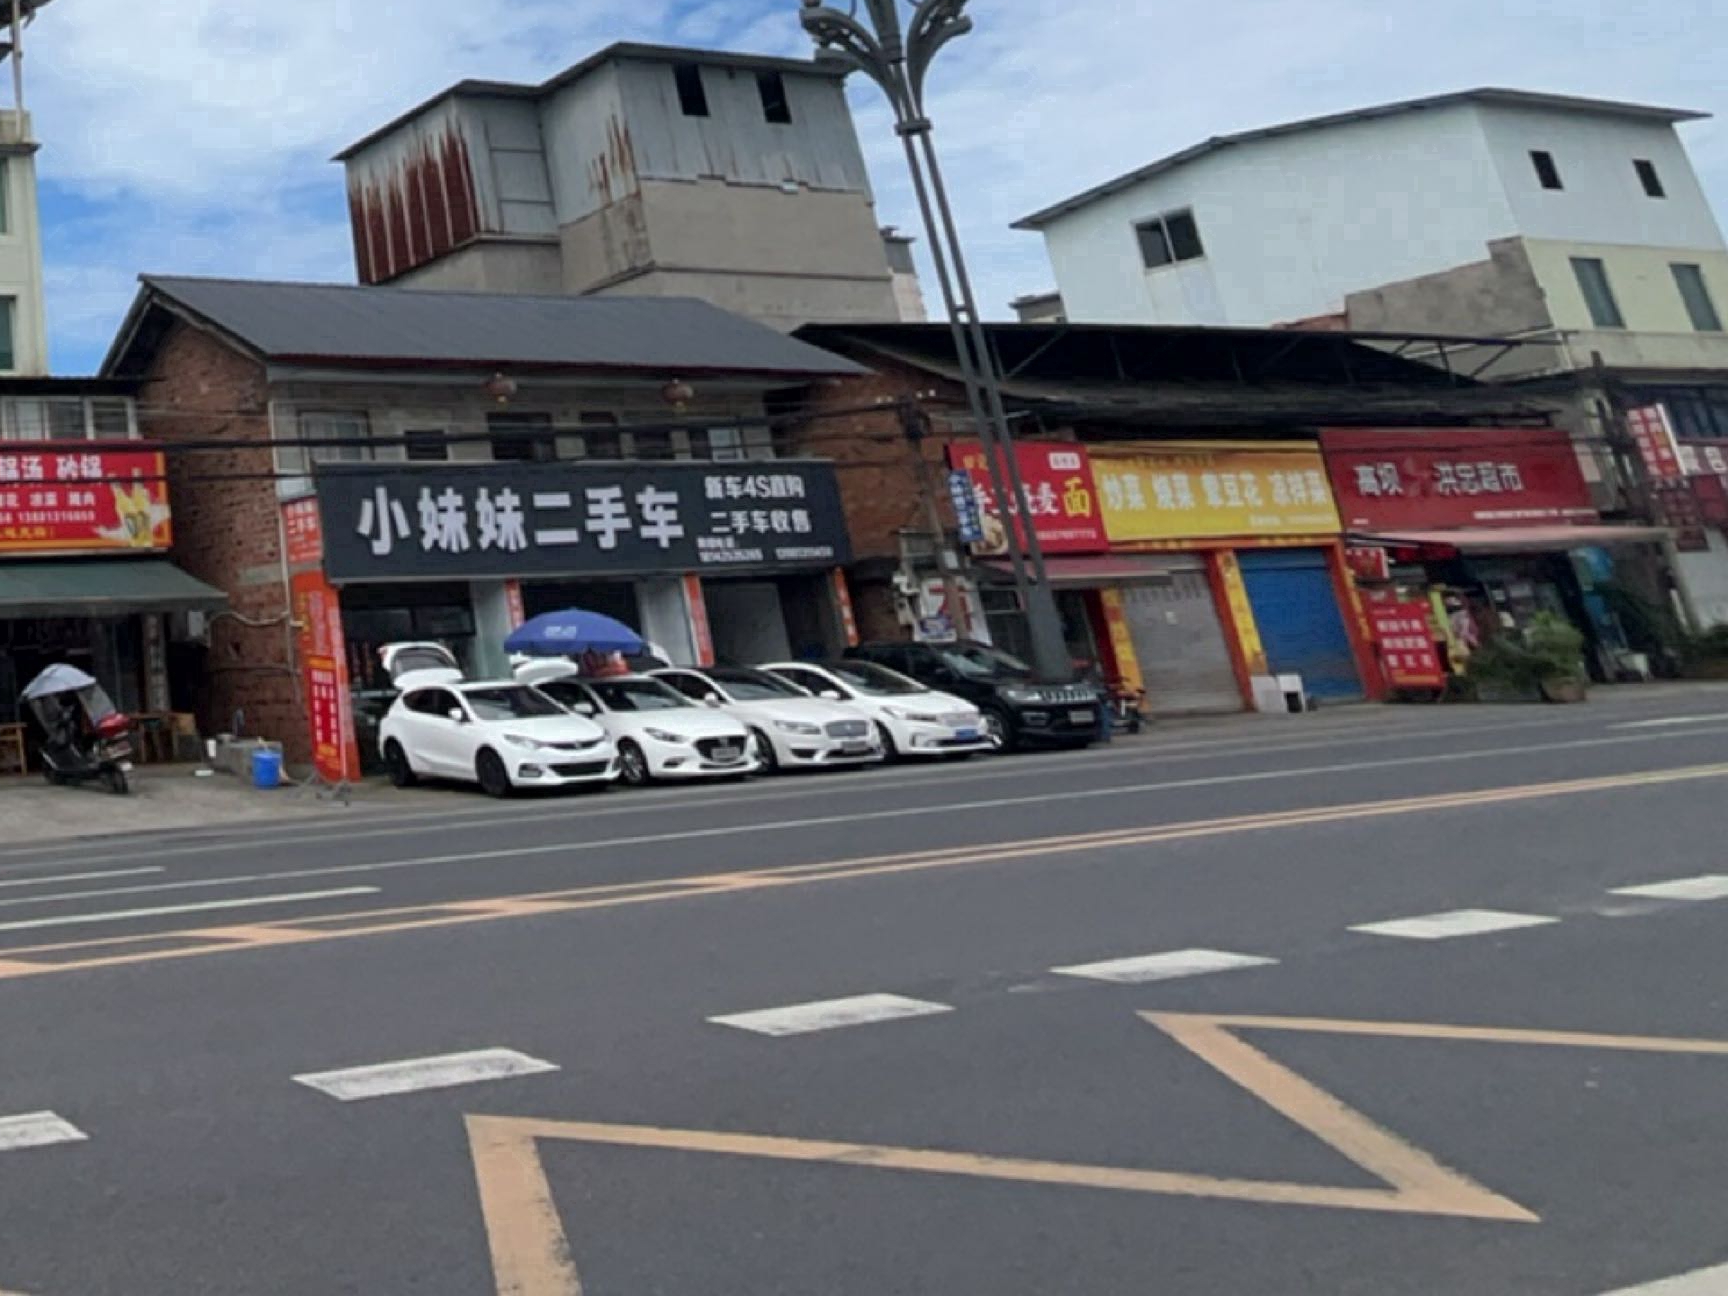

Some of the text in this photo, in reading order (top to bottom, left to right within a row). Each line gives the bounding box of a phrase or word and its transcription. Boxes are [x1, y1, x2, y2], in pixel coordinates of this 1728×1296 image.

[357, 484, 684, 555] 小妹妹二手车
